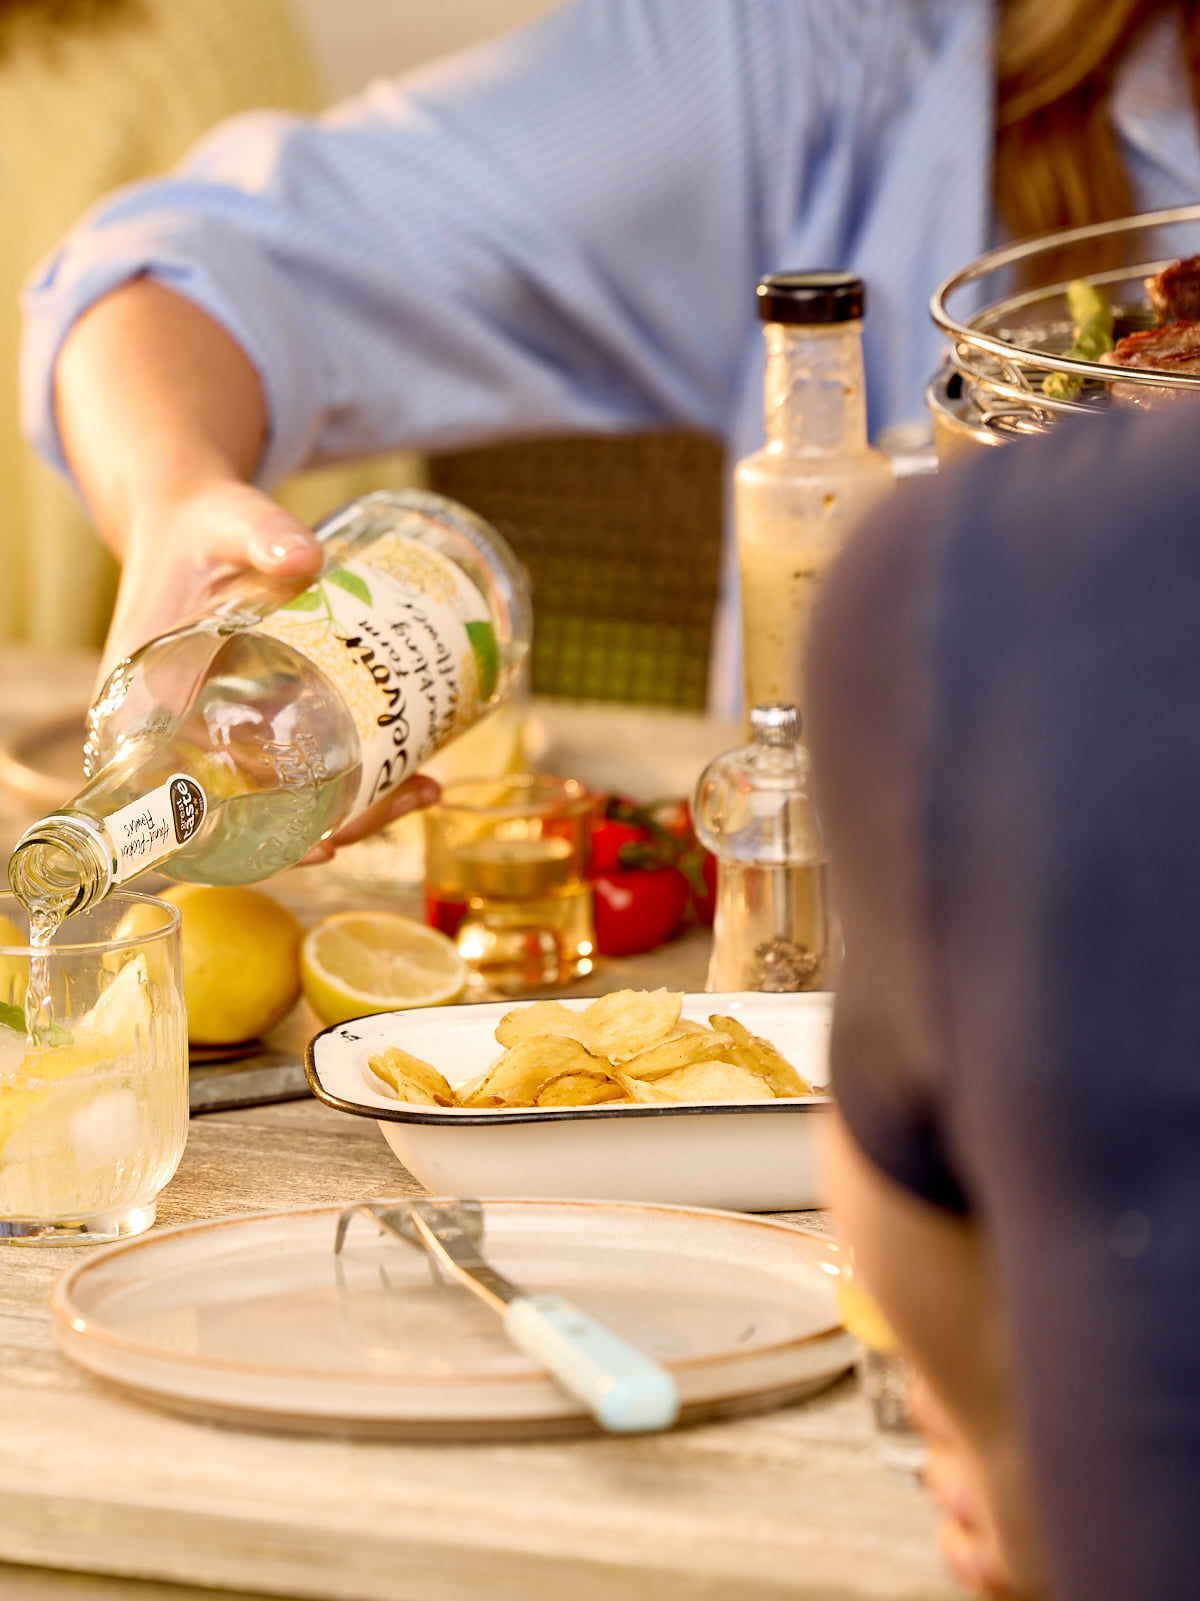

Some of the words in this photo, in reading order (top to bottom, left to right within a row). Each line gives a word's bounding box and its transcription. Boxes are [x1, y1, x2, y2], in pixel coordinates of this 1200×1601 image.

[335, 635, 410, 806] Belvoir
[176, 797, 188, 831] great
[177, 780, 195, 840] taste
